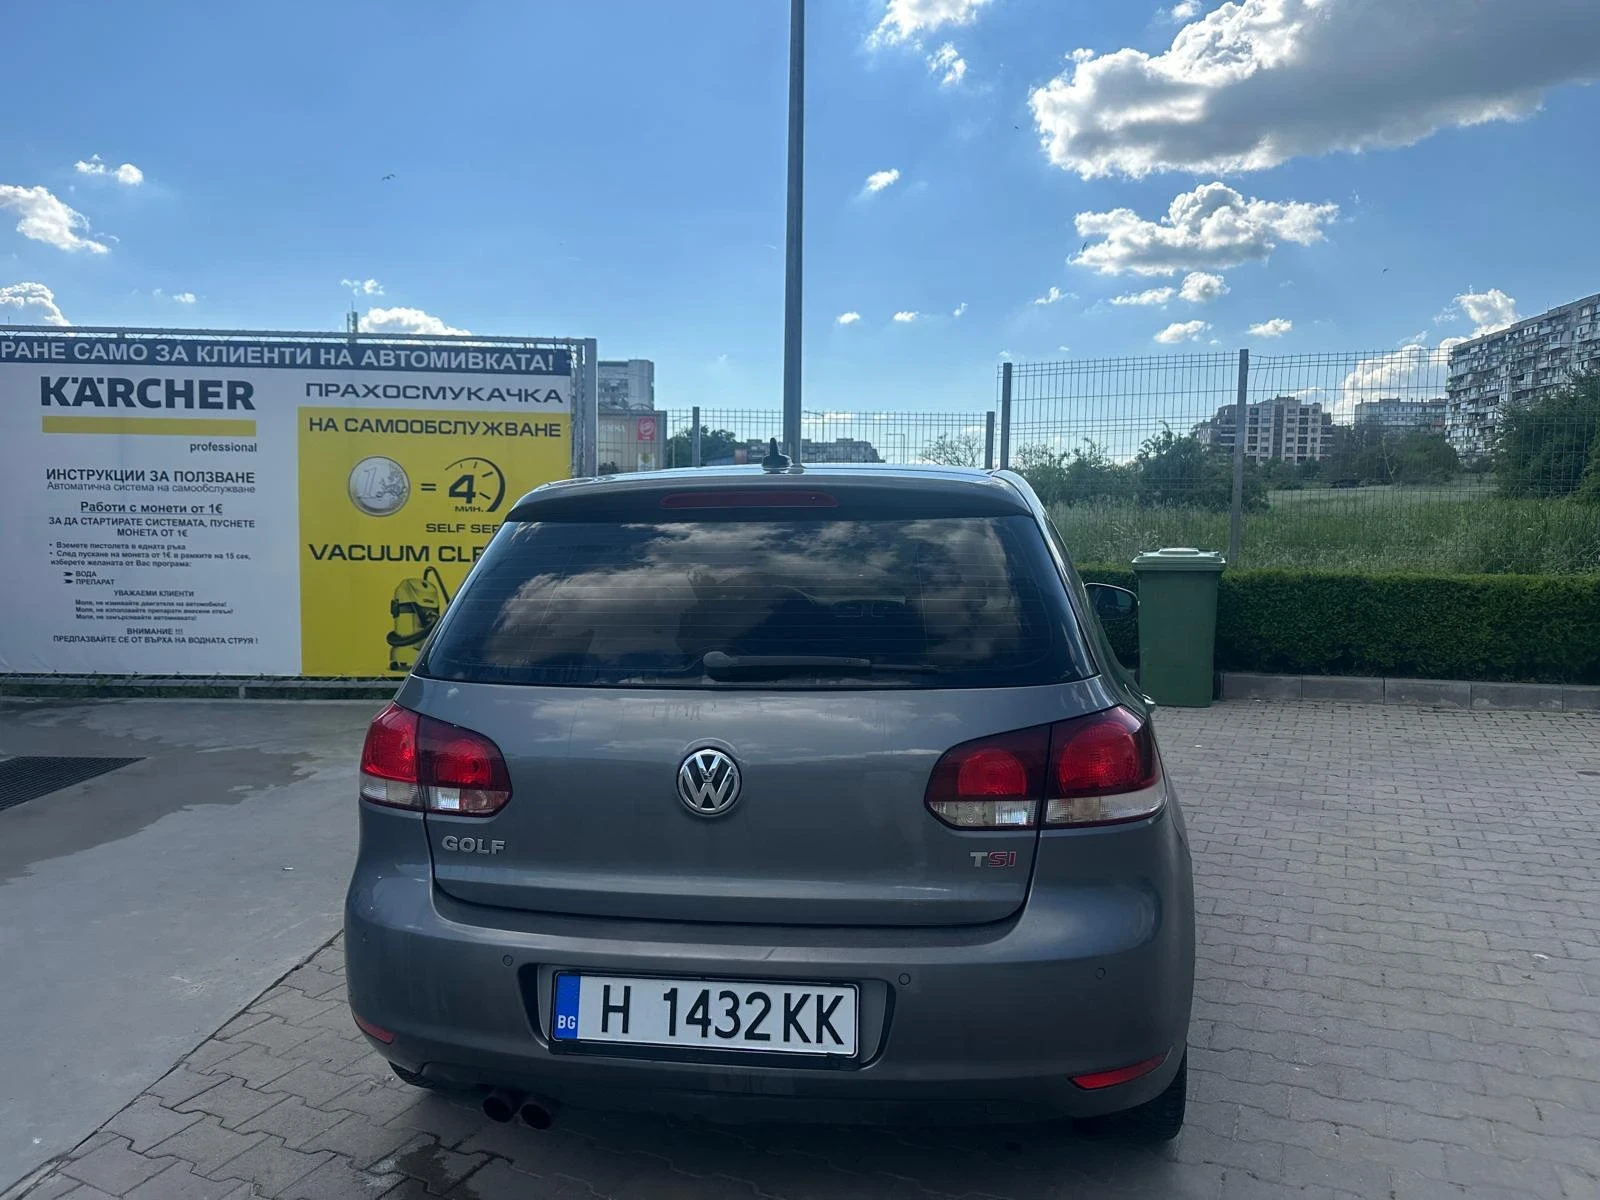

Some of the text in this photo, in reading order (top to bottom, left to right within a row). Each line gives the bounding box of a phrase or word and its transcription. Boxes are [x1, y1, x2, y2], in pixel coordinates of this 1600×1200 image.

[1, 341, 554, 371] РАНЕ САМО ЗА КЛИЕНТИ НА АВТОМИВКАТА!
[40, 376, 256, 411] KÄRCHER
[305, 383, 563, 403] ПРАХОСМУКАЧКА
[309, 417, 561, 438] НА САМООБСЛУЖВАНЕ
[189, 442, 258, 454] professional
[46, 468, 255, 484] ИНСТРУКЦИИ ЗА ПОЛЗВАНЕ
[47, 481, 256, 495] Автоматична система на самообслужване
[449, 474, 477, 504] 4
[80, 501, 223, 514] Работи с монети от 1€
[454, 505, 485, 513] МИН.
[49, 517, 255, 528] ЗА ДА СТАРТИРАТЕ СИСТЕМАТА, ПУСНЕТЕ
[426, 523, 466, 533] SELF
[117, 528, 189, 537] МОНЕТА ОТ 1€
[56, 541, 88, 549] Вземете
[138, 543, 165, 551] едната
[56, 550, 77, 558] След
[78, 551, 108, 559] пускане
[309, 544, 430, 562] VACUUM
[51, 559, 86, 567] изберете
[75, 570, 97, 578] ВОДА
[114, 589, 157, 597] УВАЖАЕМИ
[126, 627, 173, 635] ВНИМАНИЕ
[53, 634, 117, 643] ПРЕДПАЗВАЙТЕ
[131, 636, 143, 644] ОТ
[144, 636, 173, 644] ВЪРХА
[188, 636, 227, 645] ВОДНАТА
[441, 835, 506, 855] GOLF
[969, 851, 1017, 868] TSI
[600, 984, 632, 1035] H
[557, 1014, 576, 1030] BG
